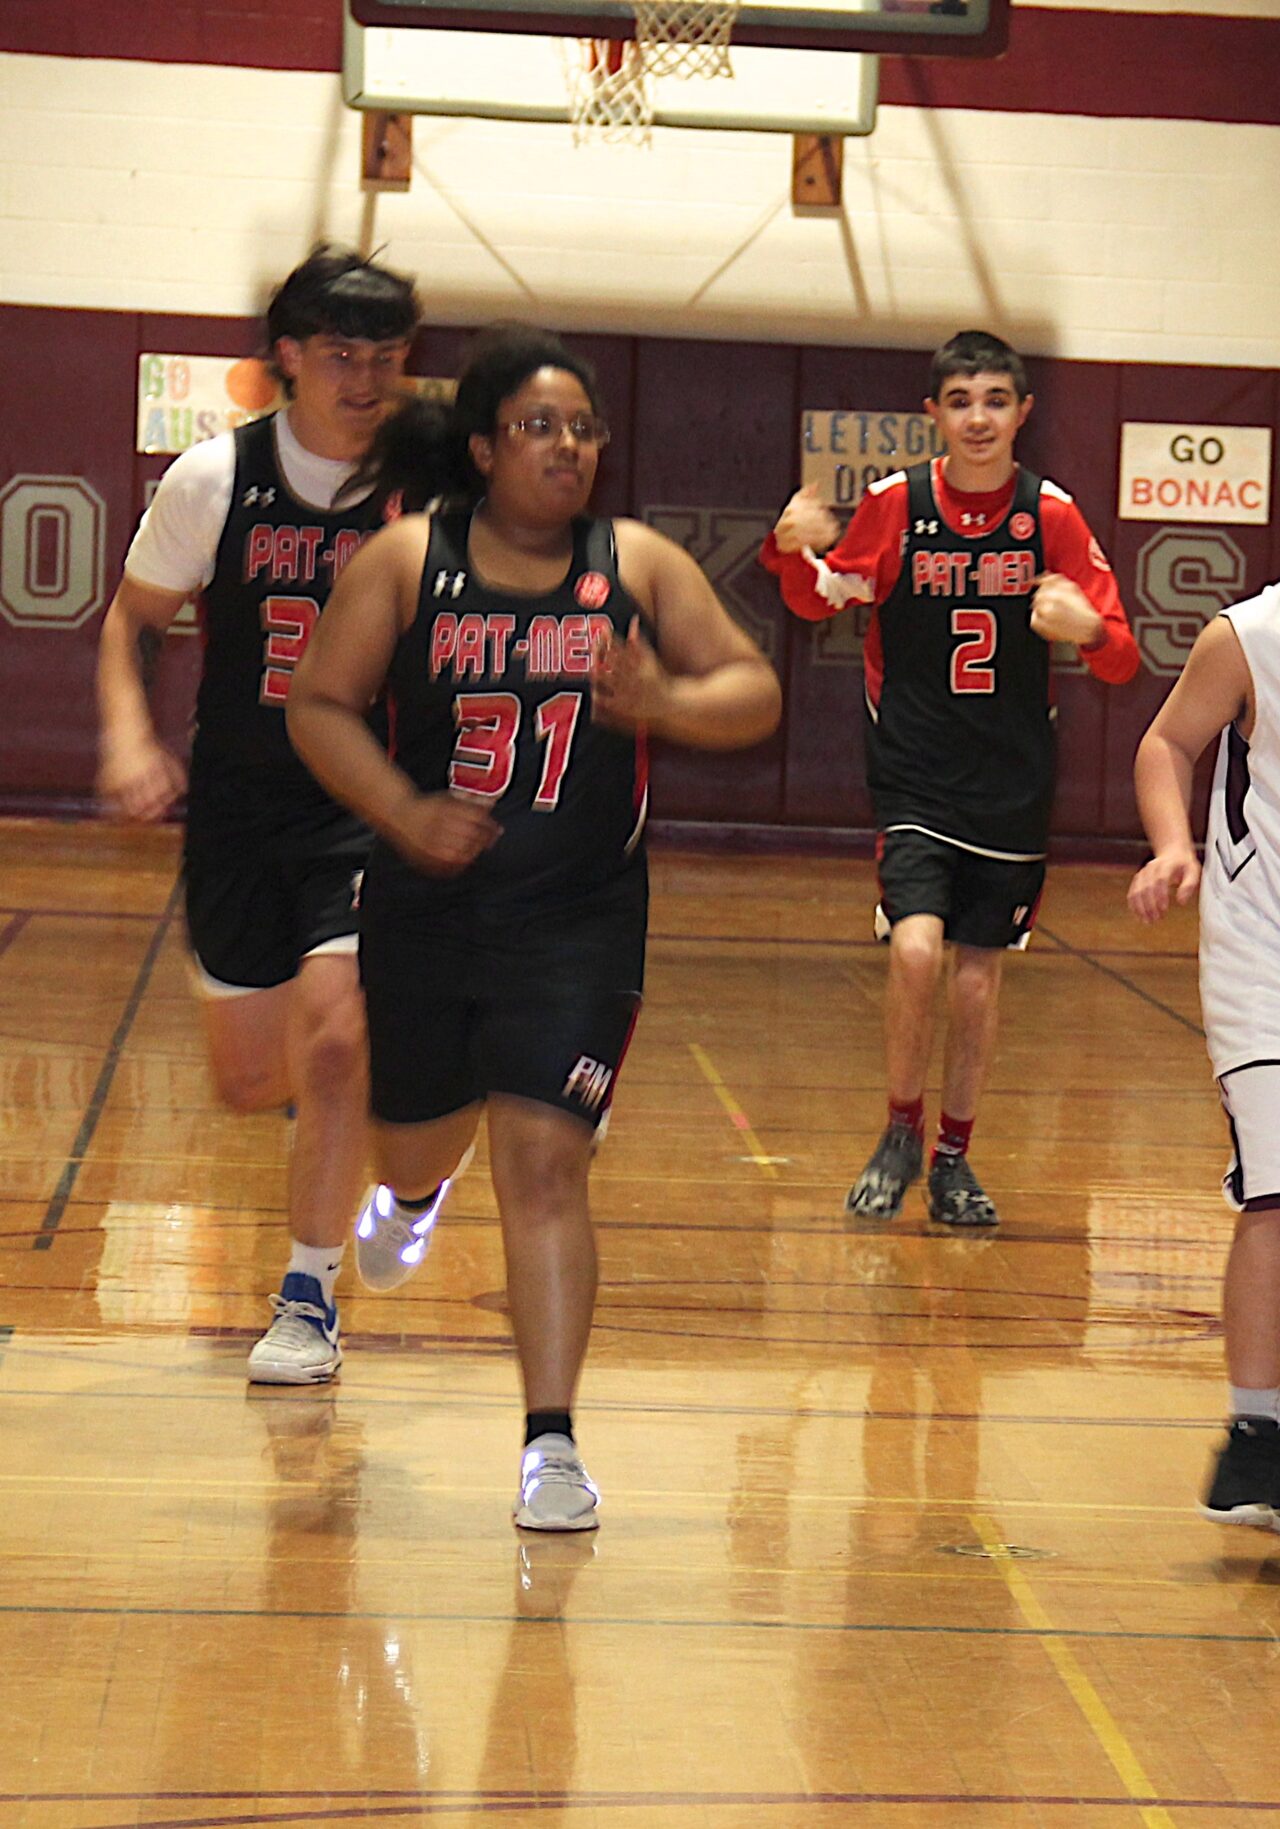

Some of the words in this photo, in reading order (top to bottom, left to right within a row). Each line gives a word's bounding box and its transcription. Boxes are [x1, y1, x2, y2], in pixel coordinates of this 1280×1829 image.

[143, 356, 190, 400] GO
[1170, 434, 1224, 465] GO
[1132, 477, 1262, 510] BONAC
[913, 550, 1036, 597] PAT-MED
[951, 608, 997, 694] 2
[450, 692, 582, 810] 31
